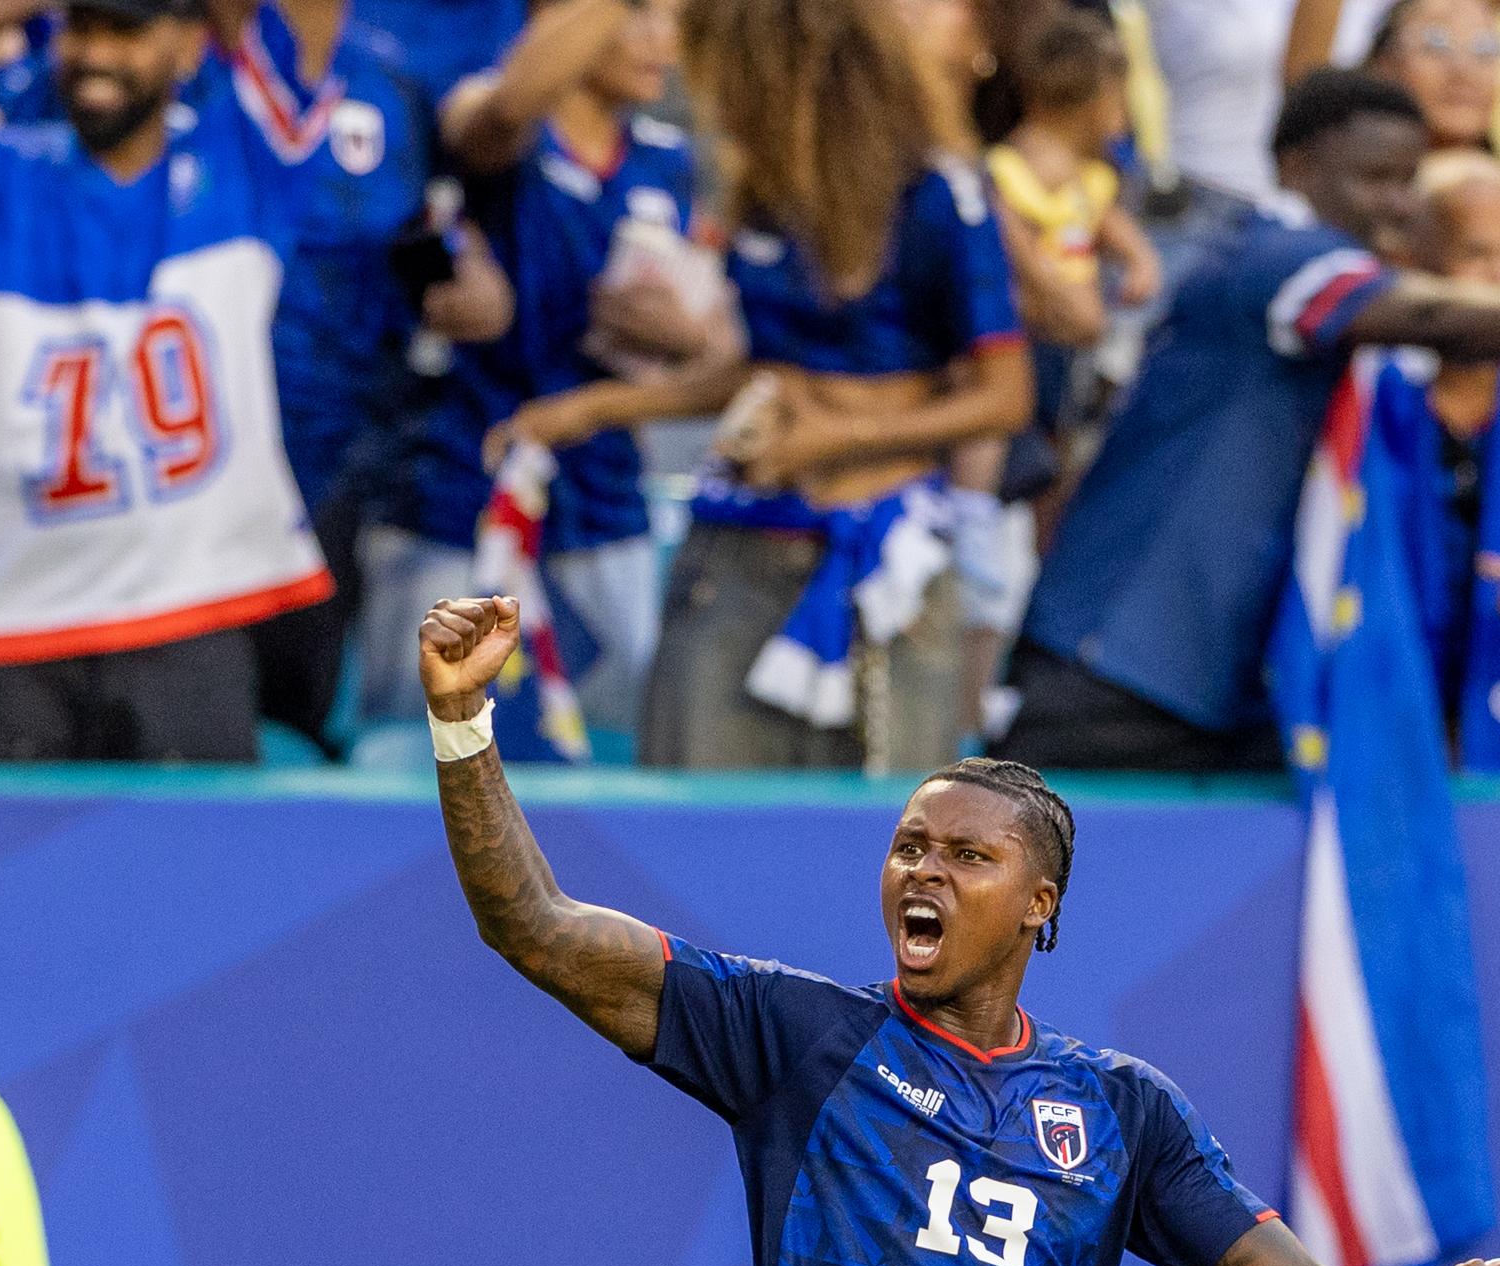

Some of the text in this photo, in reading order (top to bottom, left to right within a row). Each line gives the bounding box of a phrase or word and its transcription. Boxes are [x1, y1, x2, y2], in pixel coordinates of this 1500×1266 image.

[21, 308, 232, 518] 19
[877, 1064, 946, 1112] capelli
[1038, 1104, 1077, 1117] FCF
